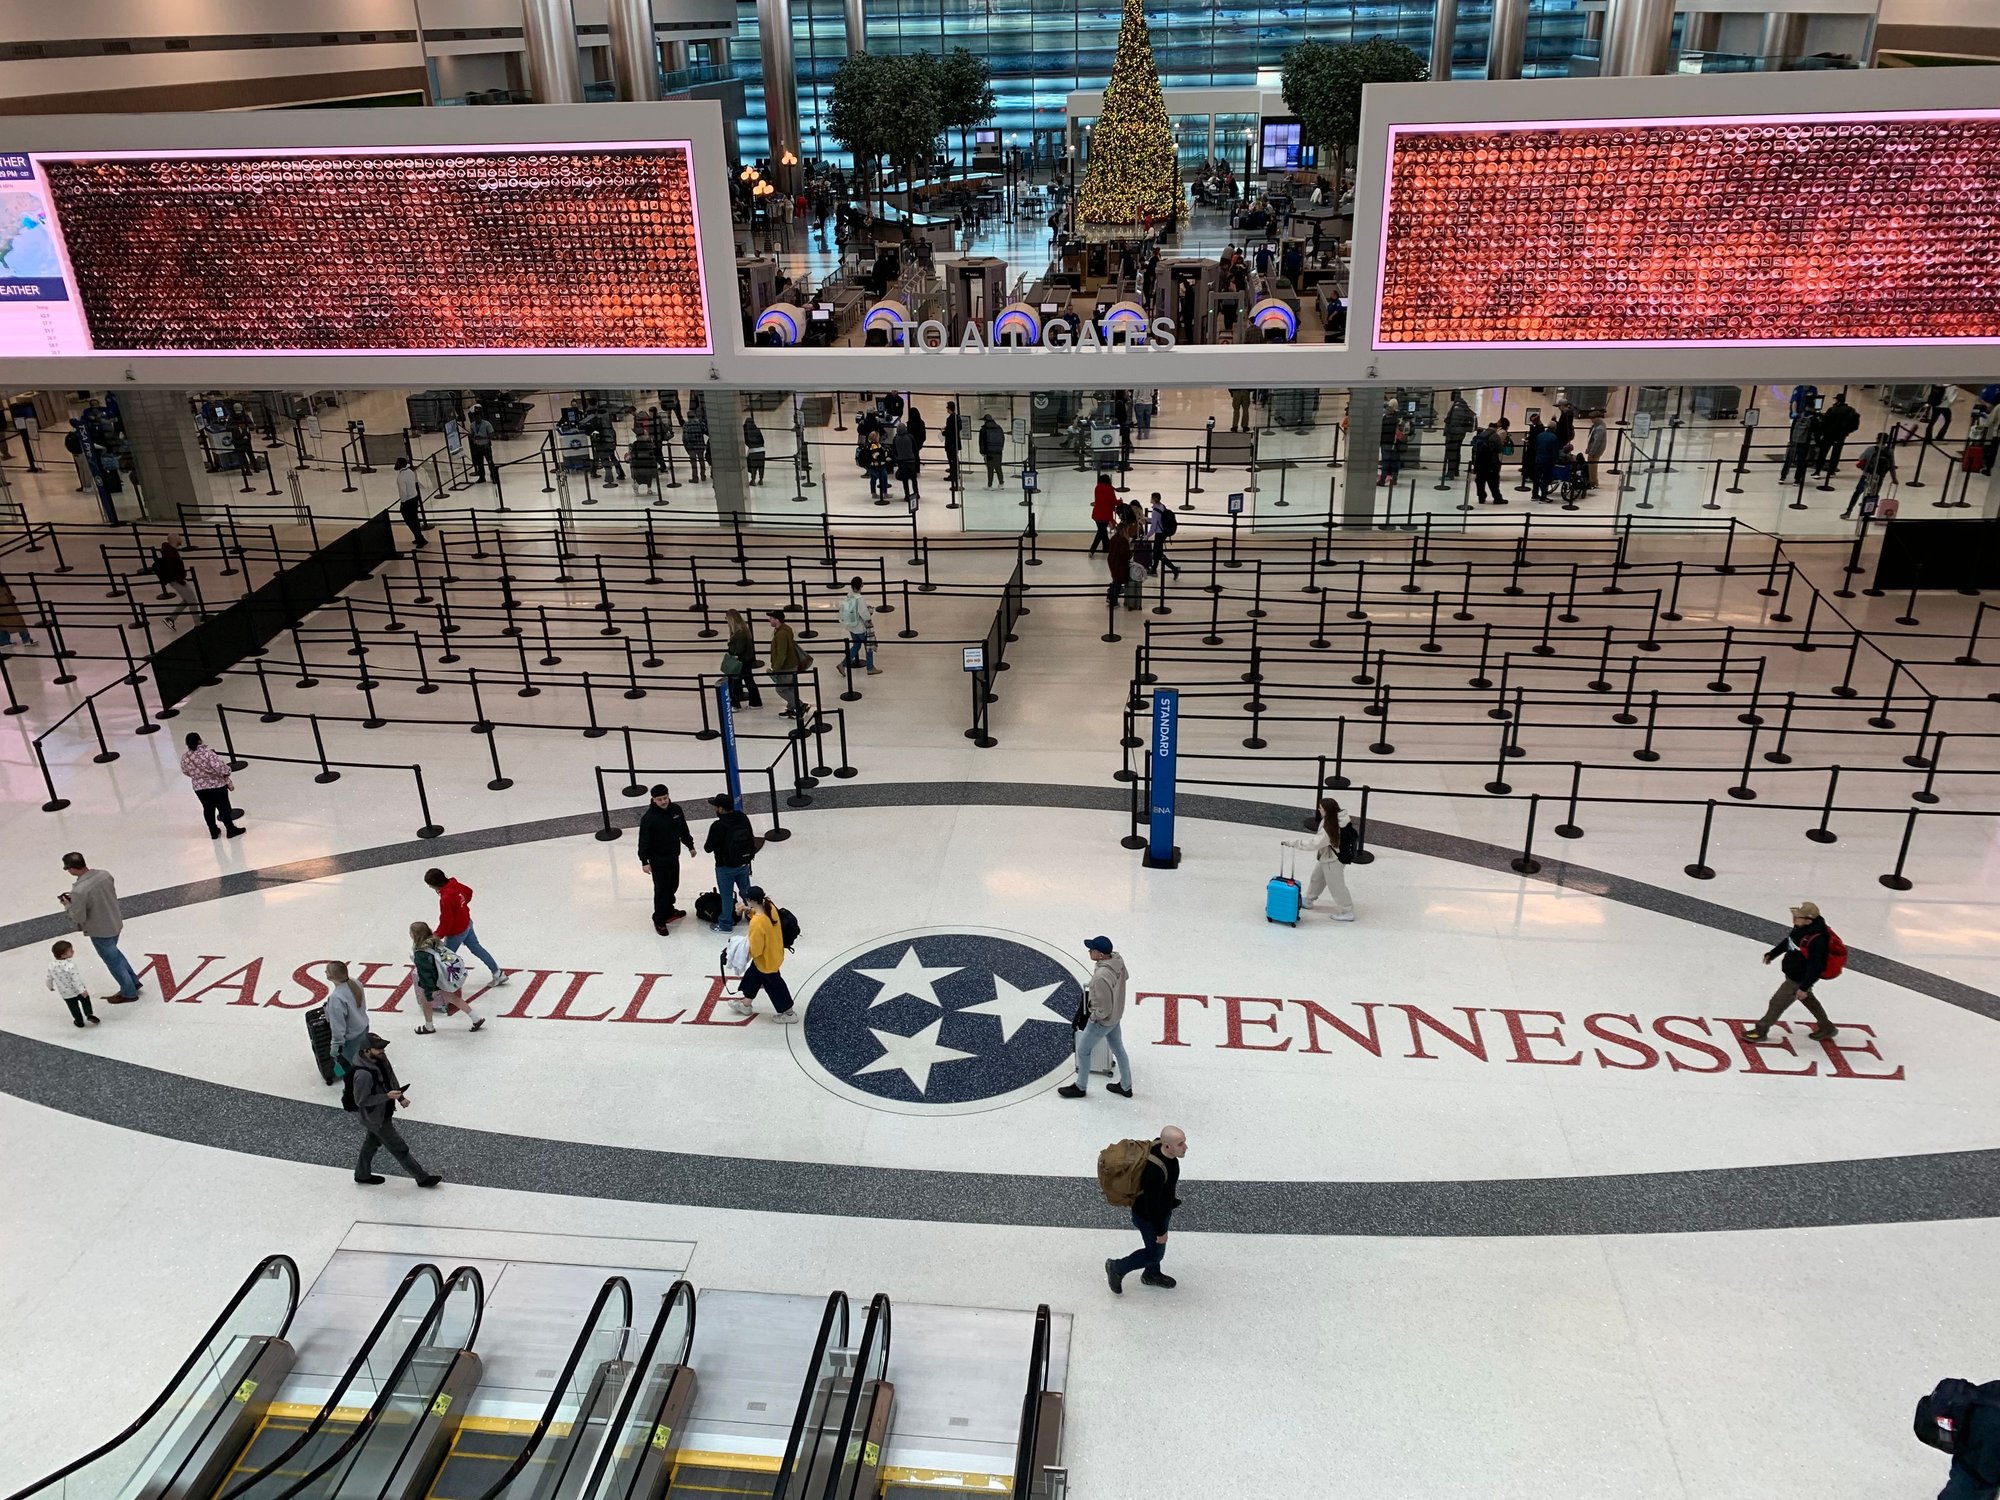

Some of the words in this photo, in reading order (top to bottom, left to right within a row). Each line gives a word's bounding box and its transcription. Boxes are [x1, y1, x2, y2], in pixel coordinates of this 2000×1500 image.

[892, 319, 947, 354] TO
[959, 320, 1032, 354] ALL
[1042, 317, 1177, 354] GATES
[78, 424, 88, 441] TSA
[1160, 698, 1170, 757] STANDARD
[1153, 806, 1171, 814] BNA
[1135, 992, 1906, 1081] TENNESSEE
